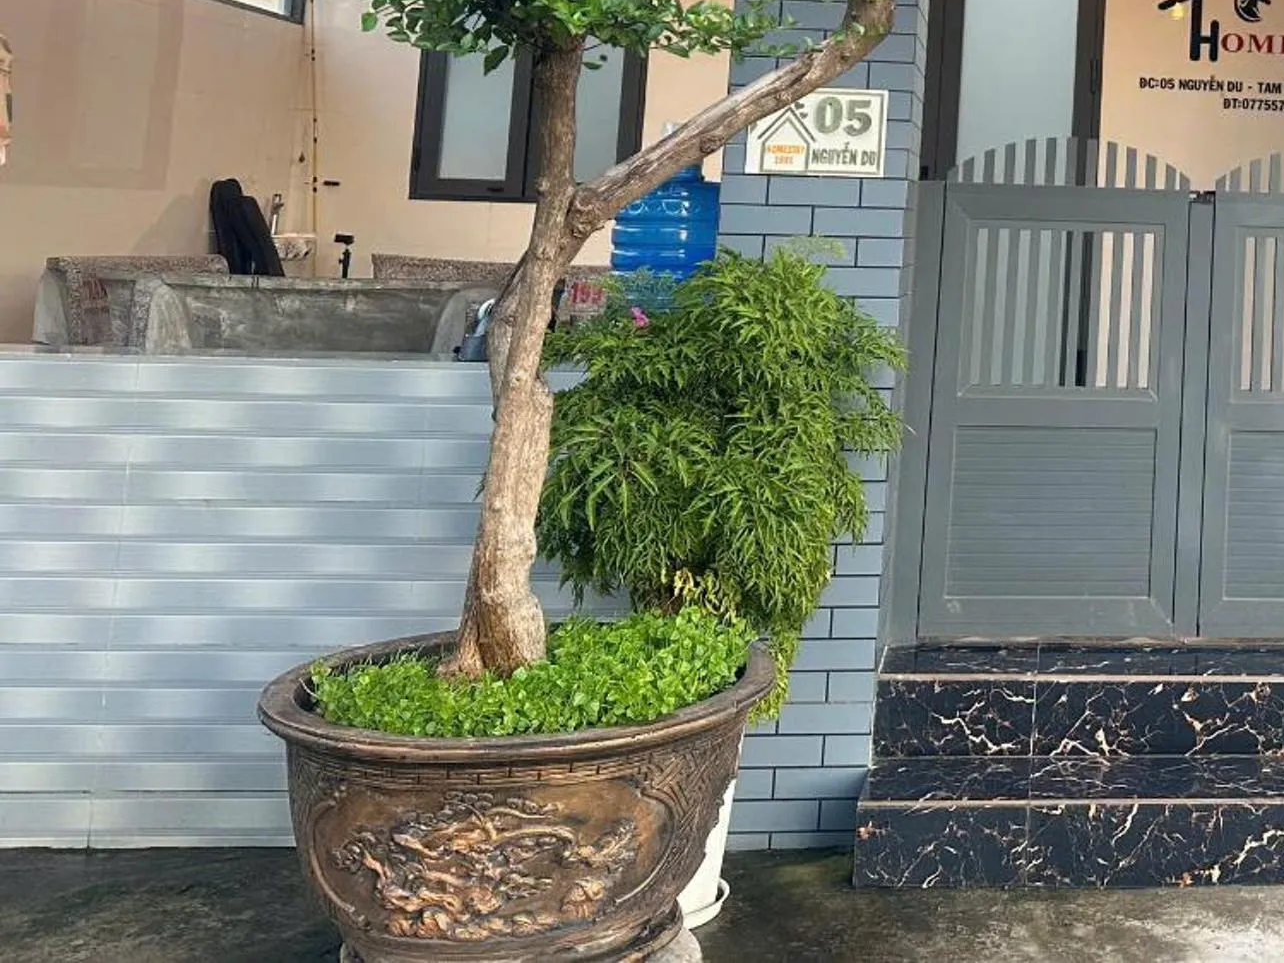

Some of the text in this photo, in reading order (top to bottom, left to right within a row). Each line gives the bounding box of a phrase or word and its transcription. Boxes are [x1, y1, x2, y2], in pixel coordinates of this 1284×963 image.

[1227, 80, 1244, 92] DU
[1257, 82, 1282, 94] TAM
[813, 96, 873, 137] 05
